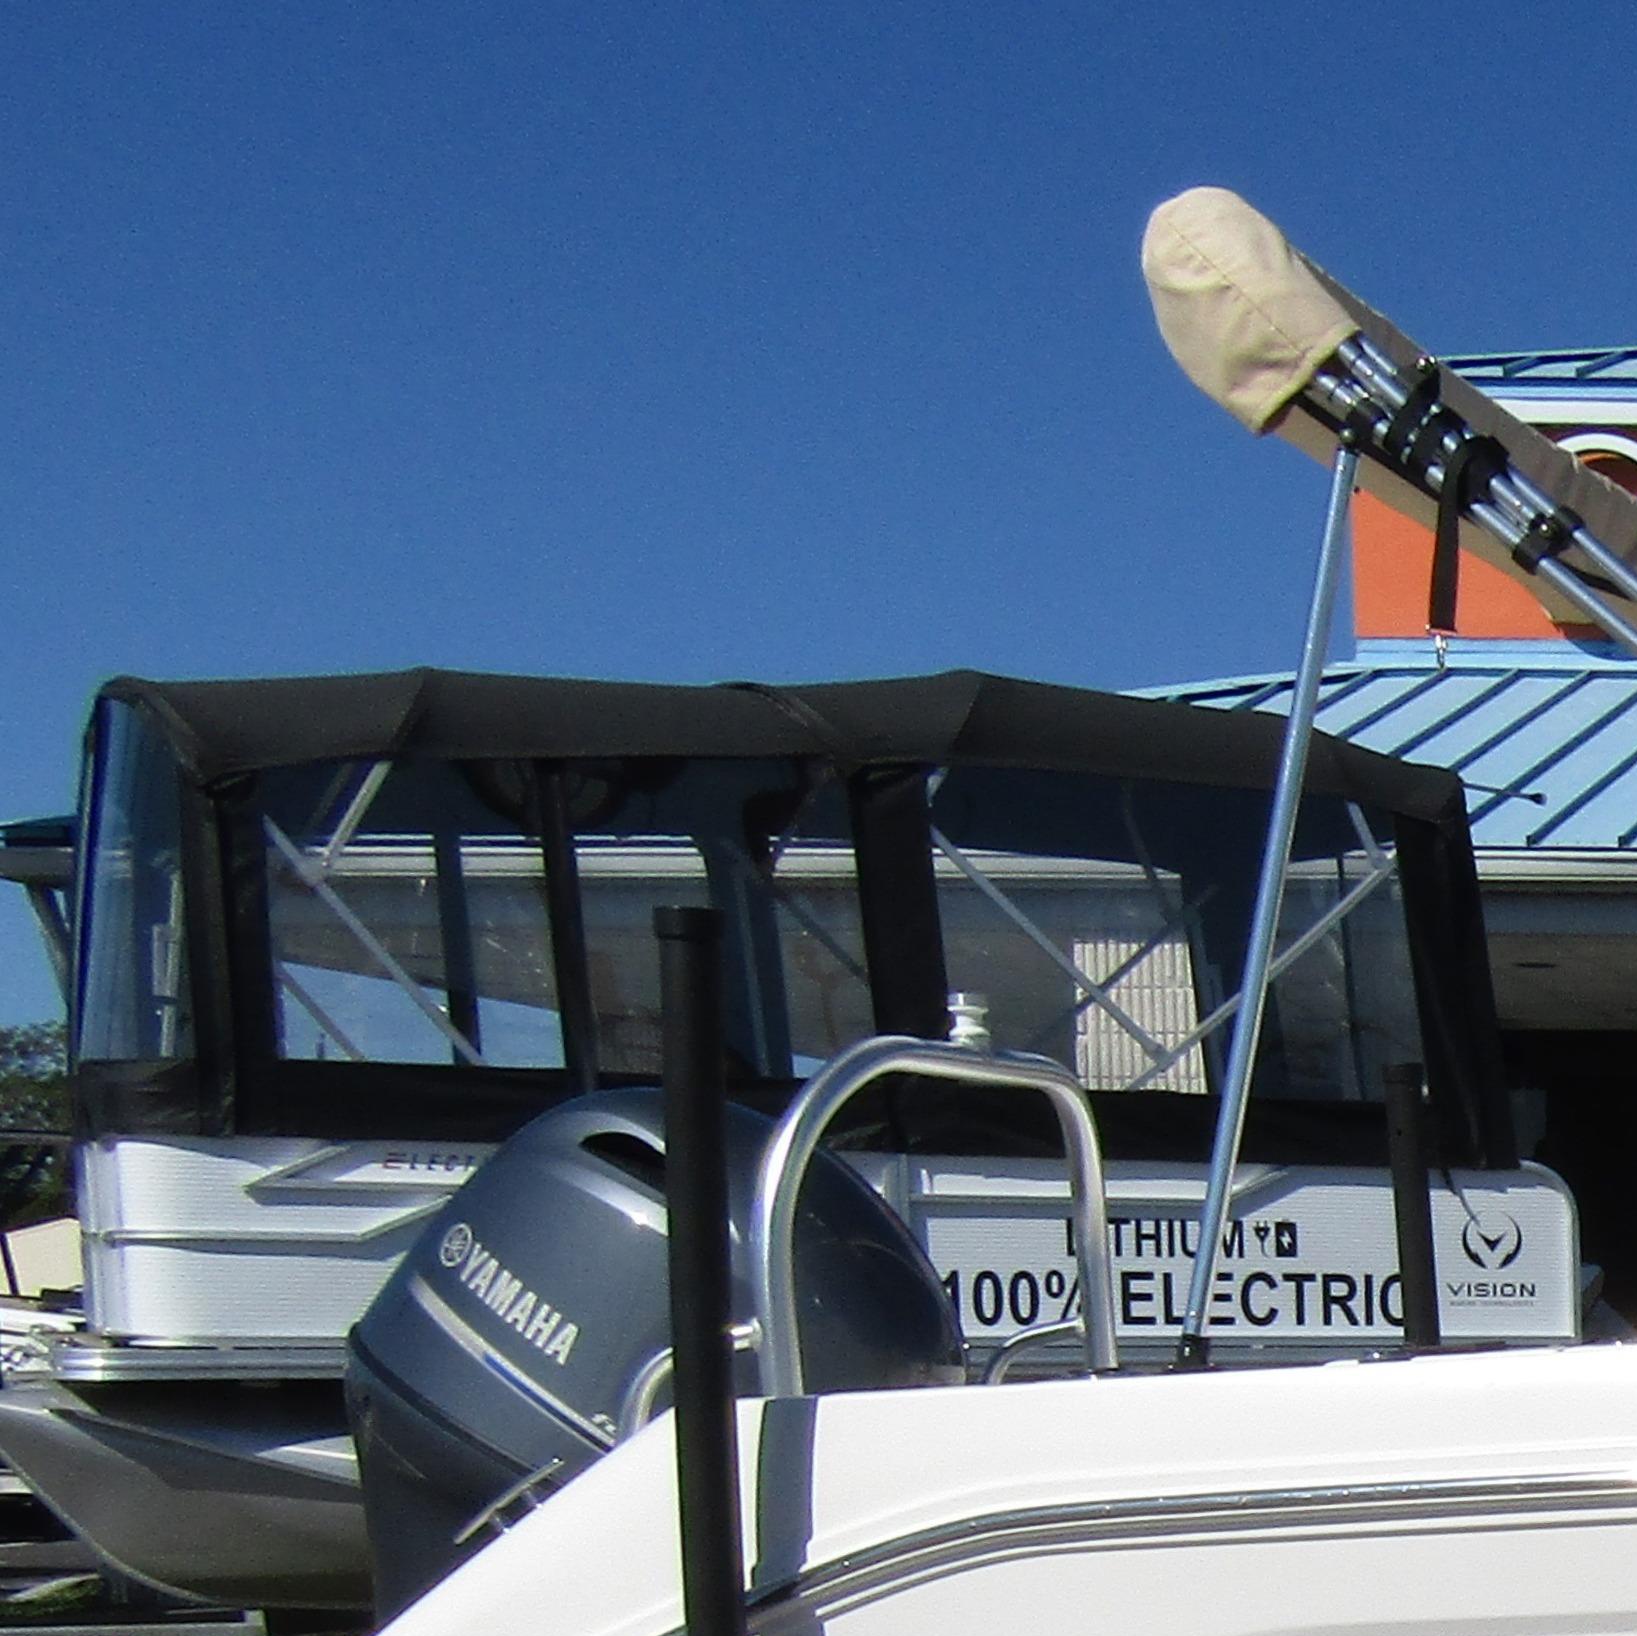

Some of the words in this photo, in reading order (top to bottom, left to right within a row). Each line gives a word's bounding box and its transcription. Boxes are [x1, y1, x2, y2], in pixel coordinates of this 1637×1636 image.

[1066, 1218, 1244, 1258] LTHIUM
[460, 1243, 579, 1365] YAMAHA
[1446, 1283, 1536, 1297] VISION
